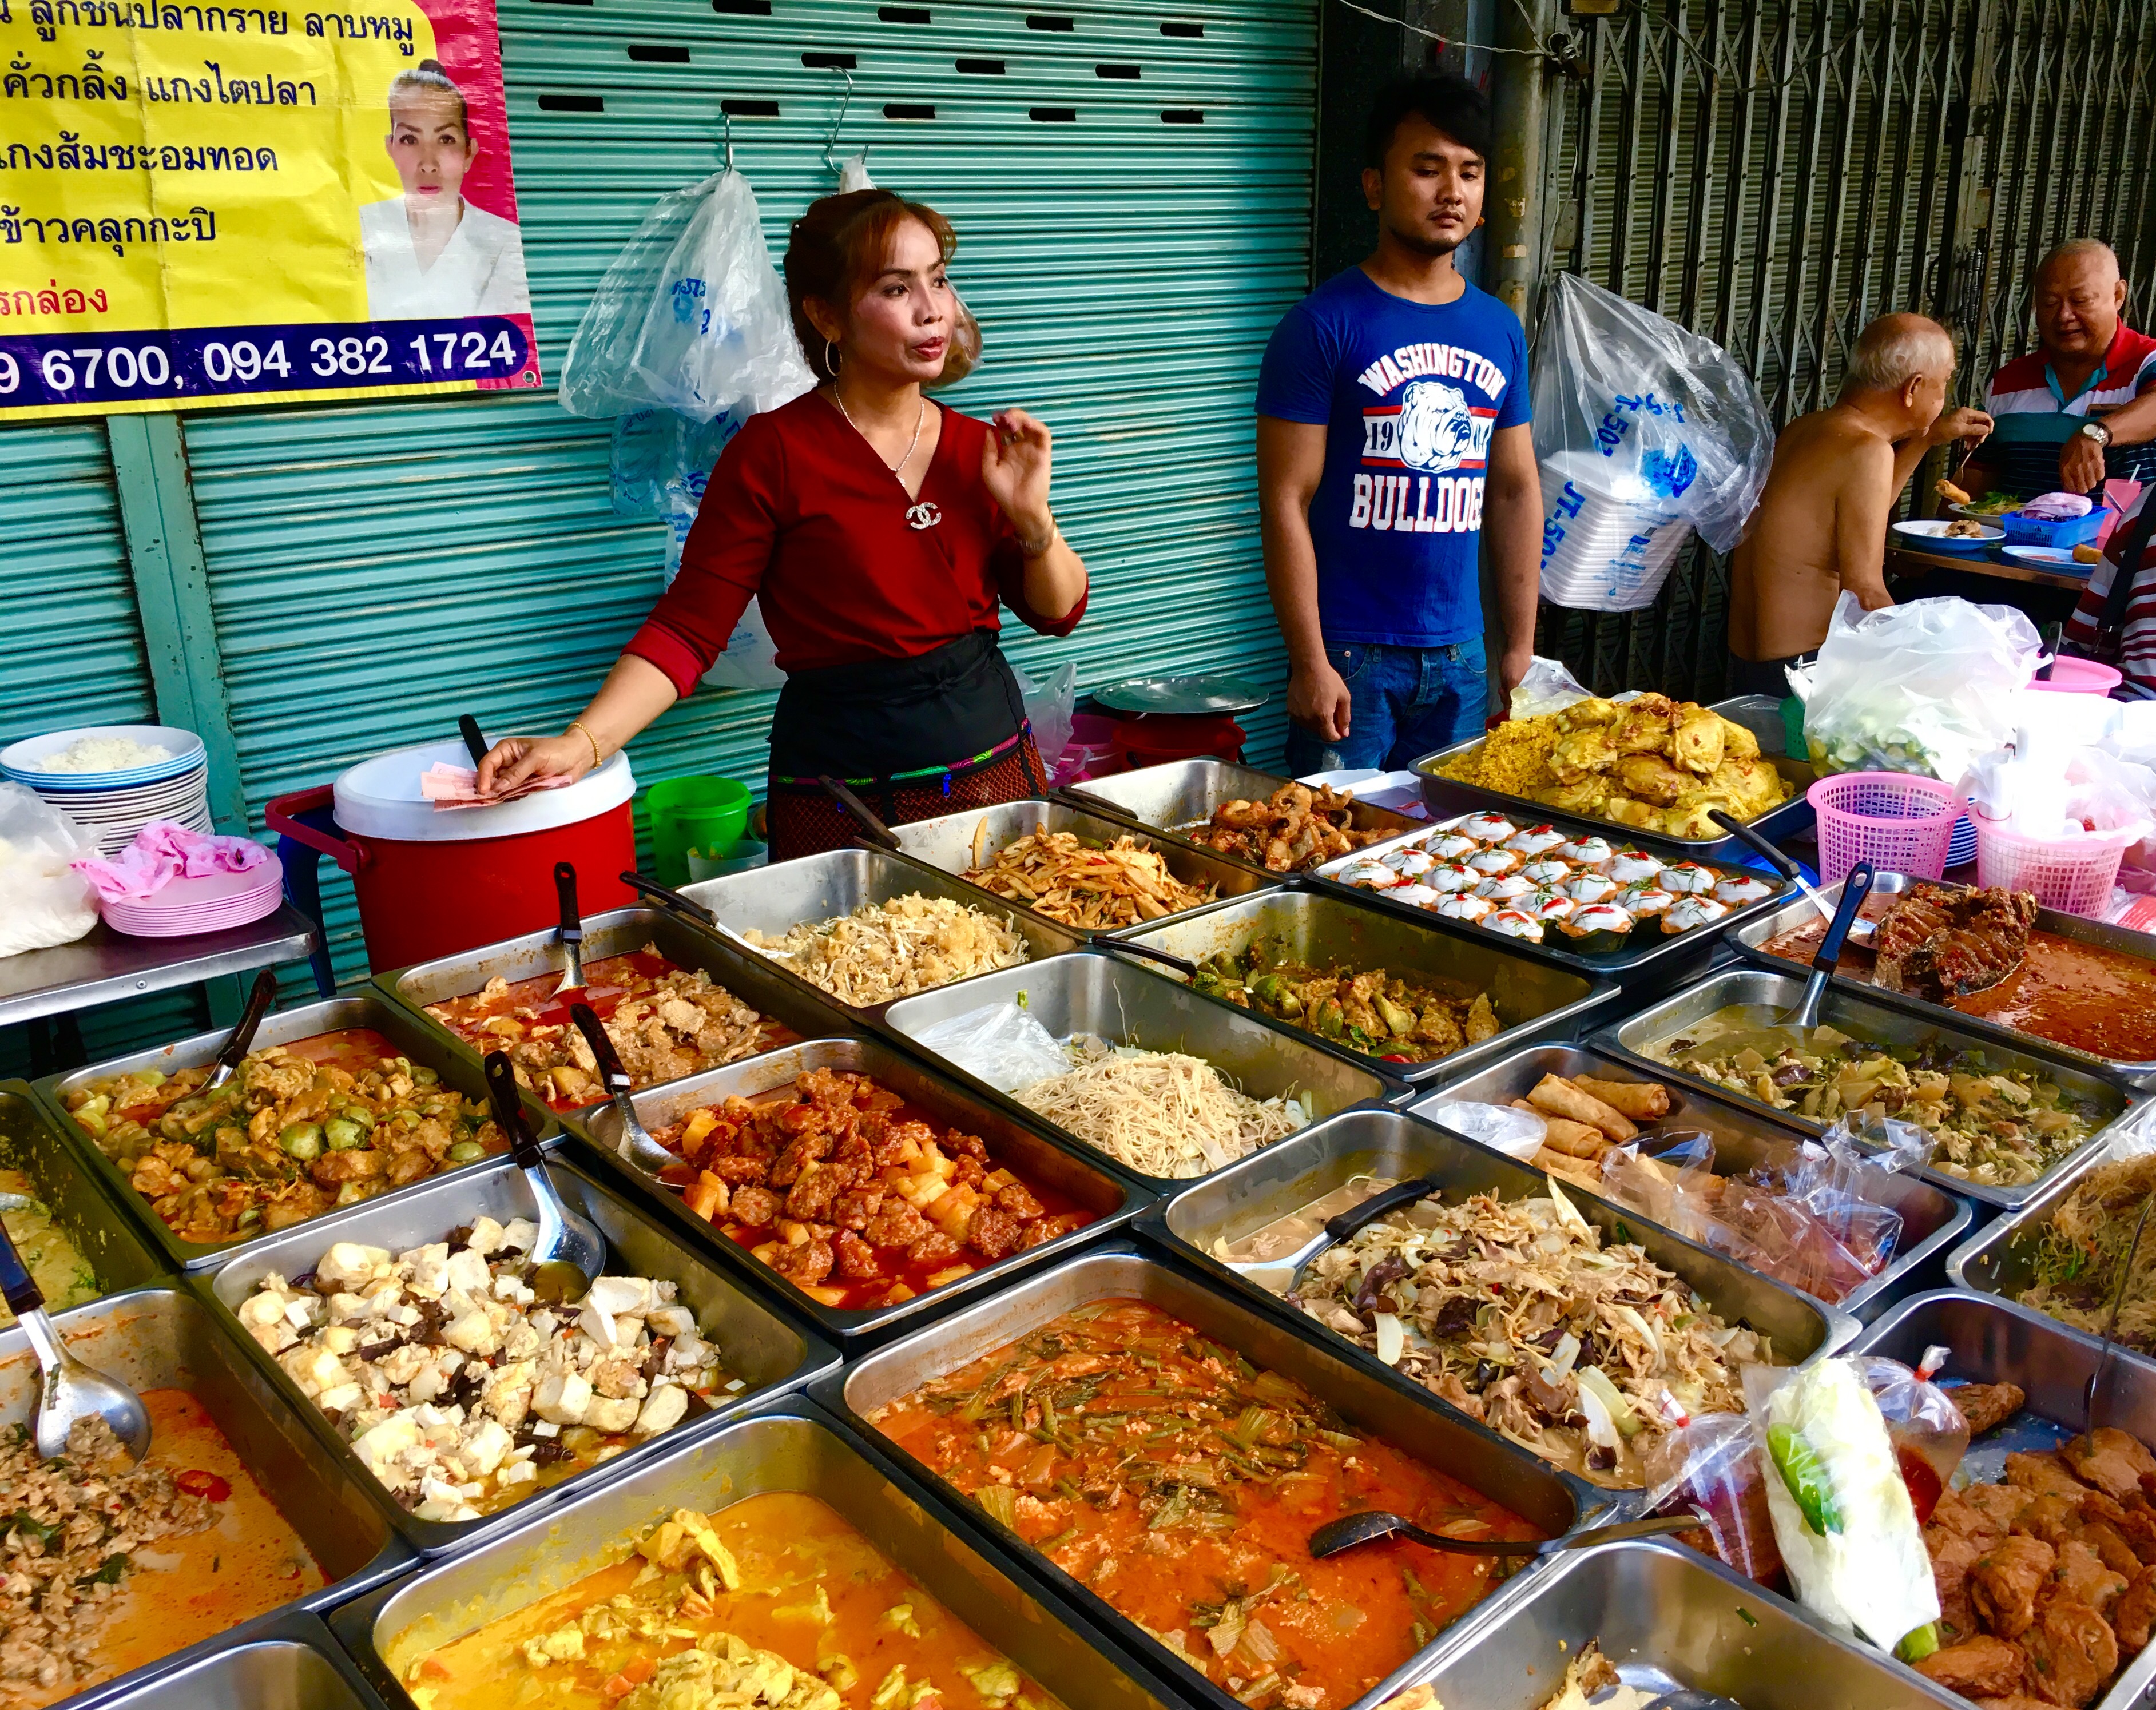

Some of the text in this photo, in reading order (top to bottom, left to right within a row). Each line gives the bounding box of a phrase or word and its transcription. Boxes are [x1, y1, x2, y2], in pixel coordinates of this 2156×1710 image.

[304, 13, 414, 56] ลาบหมู
[3, 49, 316, 106] คั่วกลิ้ง แกงไตปลา
[0, 205, 216, 257] ข้าวคลุกกะปิ
[42, 345, 184, 391] 6700,
[203, 340, 291, 381] 094
[309, 336, 392, 376] 382
[410, 331, 516, 371] 1724
[1357, 343, 1507, 401] WASHINGTON
[1369, 421, 1394, 452] 19
